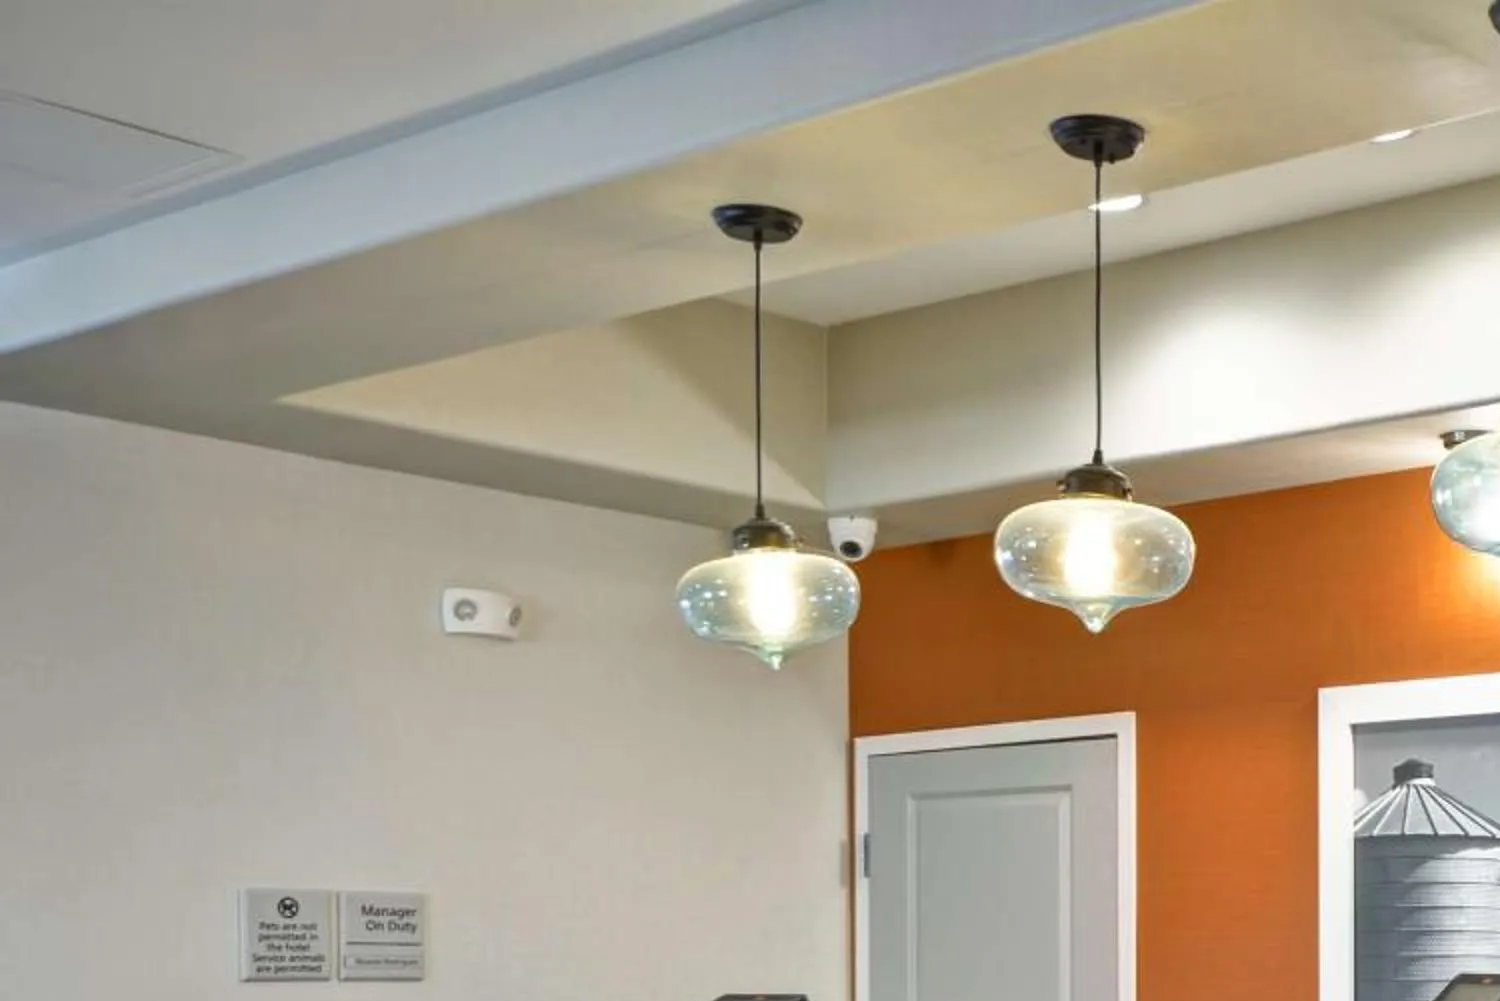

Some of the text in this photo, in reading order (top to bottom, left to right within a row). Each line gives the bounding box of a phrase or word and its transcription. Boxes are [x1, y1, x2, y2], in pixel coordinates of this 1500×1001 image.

[361, 904, 417, 920] Manager
[366, 919, 417, 935] On Duty
